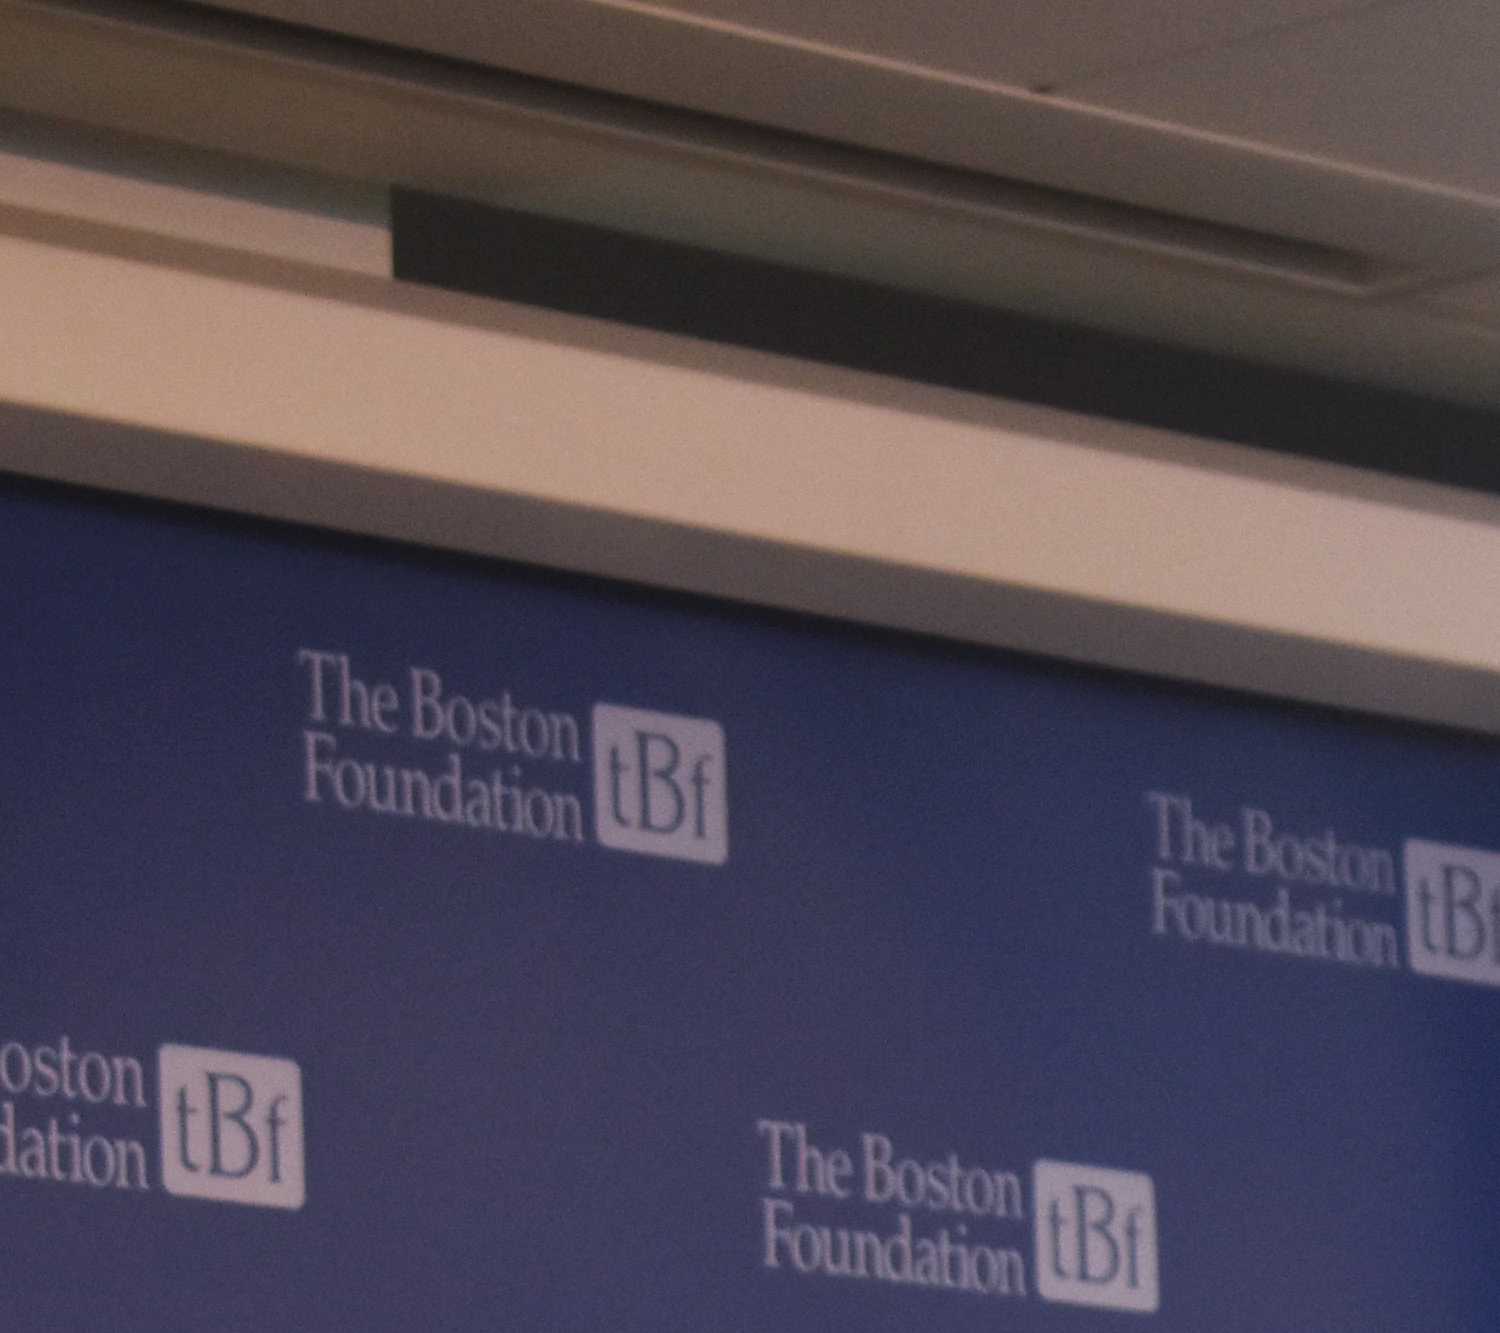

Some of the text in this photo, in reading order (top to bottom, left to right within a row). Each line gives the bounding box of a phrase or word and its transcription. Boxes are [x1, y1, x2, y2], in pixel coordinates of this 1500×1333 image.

[298, 648, 581, 762] The Boston
[303, 730, 584, 843] Foundation
[1148, 791, 1396, 894] The Boston
[1151, 867, 1398, 968] Foundation
[757, 1118, 1023, 1218] The Boston
[763, 1198, 1026, 1296] Foundation
